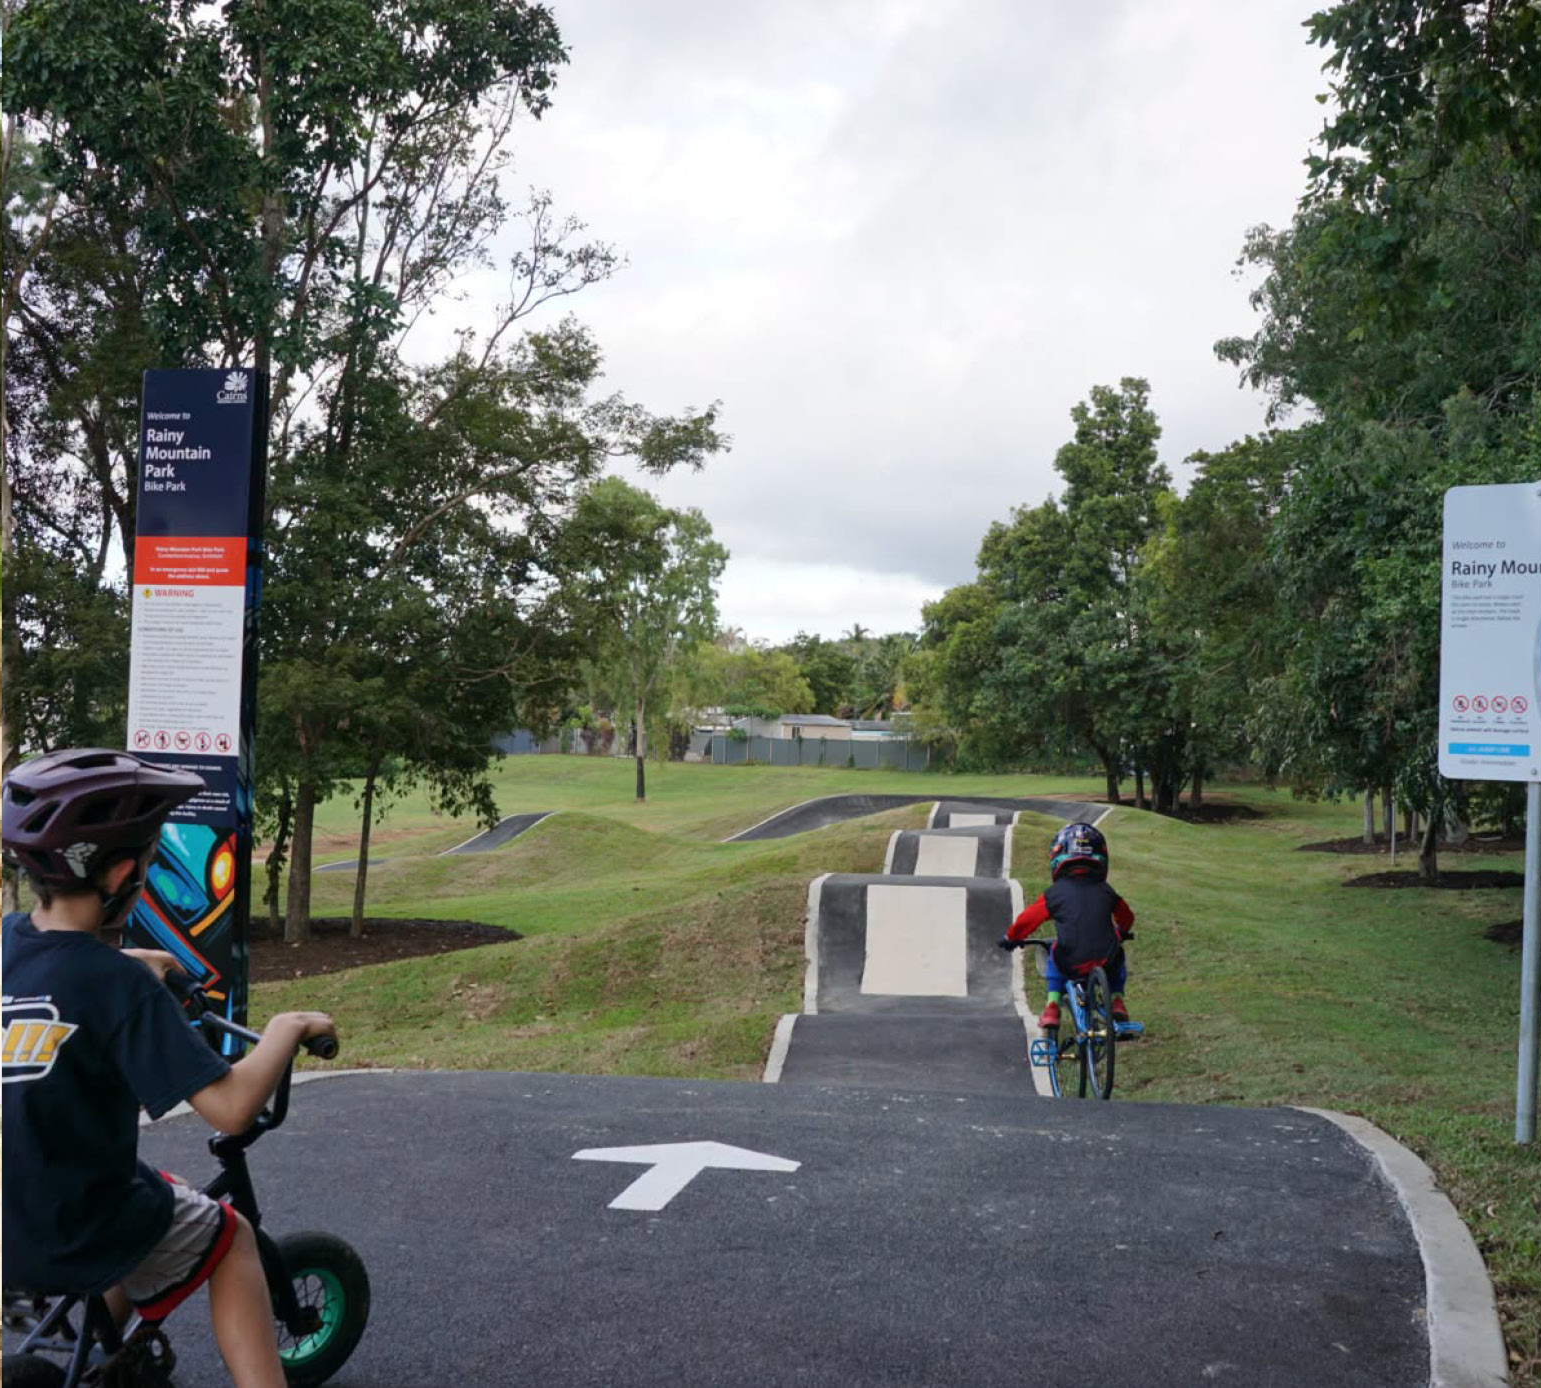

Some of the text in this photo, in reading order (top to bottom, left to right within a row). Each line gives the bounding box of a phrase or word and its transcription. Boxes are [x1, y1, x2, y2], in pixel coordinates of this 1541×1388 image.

[216, 390, 248, 400] Cairns
[147, 412, 191, 421] Welcome to
[146, 428, 184, 445] Rainy
[145, 446, 211, 460] Mountain
[144, 463, 175, 478] Park
[144, 481, 186, 492] Bike Park
[1452, 540, 1506, 551] Welcome to
[1452, 559, 1496, 579] Rainy
[1452, 579, 1493, 590] Bike Park
[154, 589, 195, 598] WARNING
